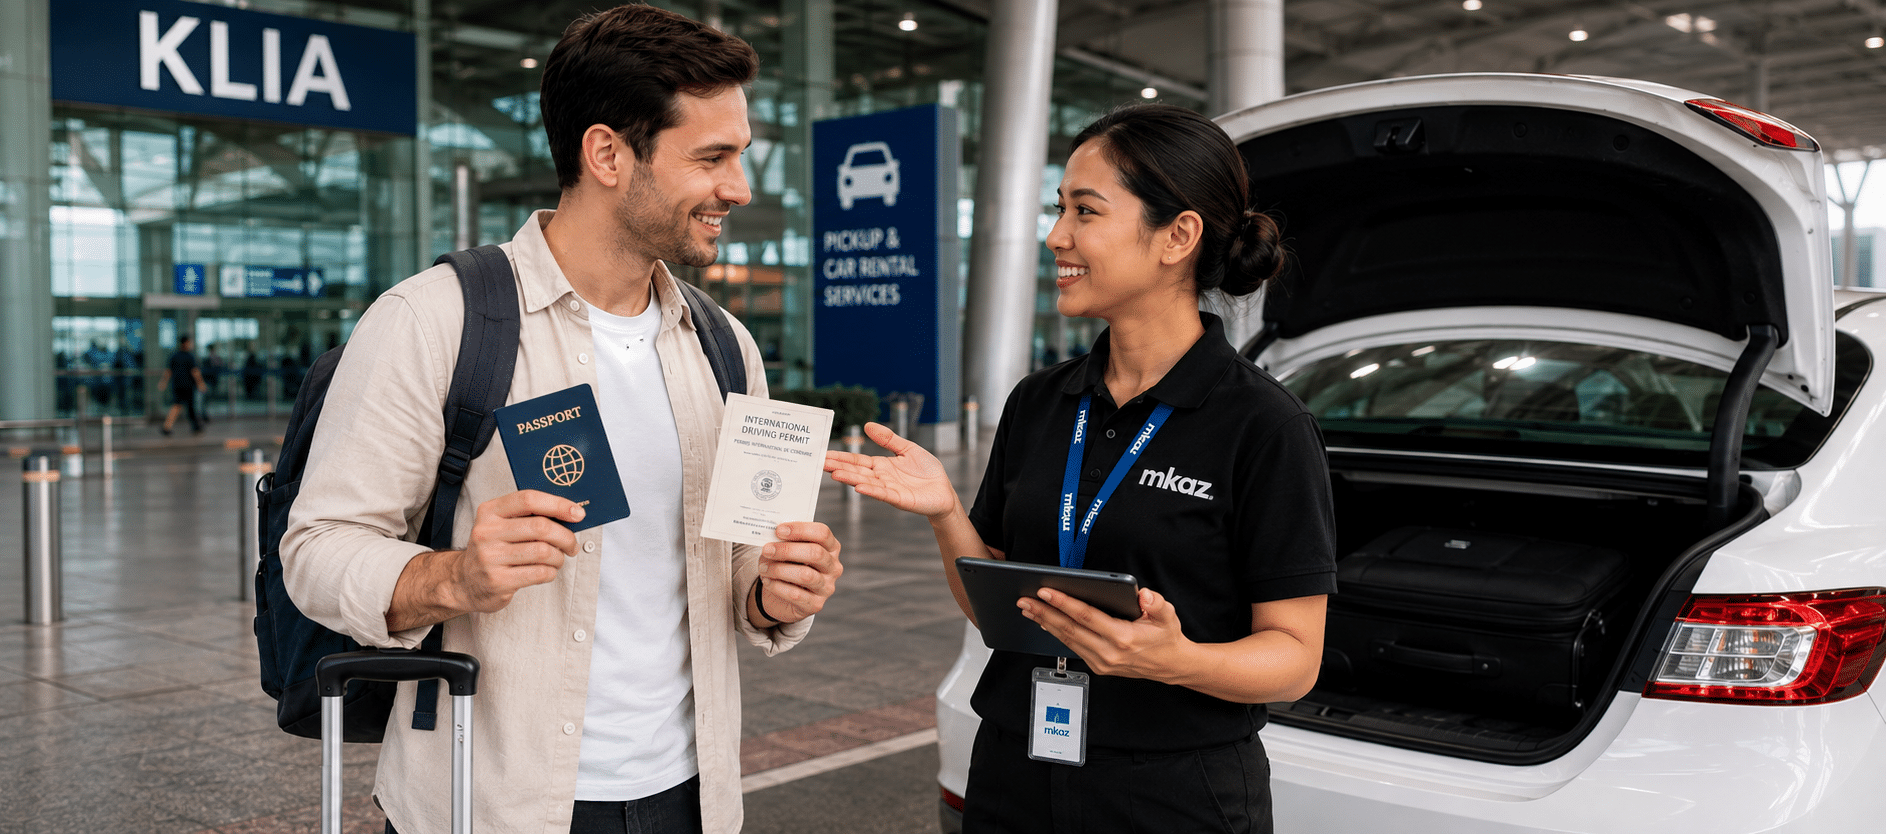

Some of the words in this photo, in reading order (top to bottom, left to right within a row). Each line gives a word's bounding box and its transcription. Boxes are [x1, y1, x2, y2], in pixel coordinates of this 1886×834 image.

[139, 10, 351, 111] KLIA
[823, 227, 884, 251] PICKUP
[886, 227, 900, 249] &
[823, 258, 857, 279] CAR
[859, 255, 920, 277] RENTAL
[824, 284, 901, 307] SERVICES
[516, 406, 581, 435] PASSPORT
[744, 415, 811, 434] INTERNATIONAL
[741, 425, 777, 439] DRIVING
[779, 432, 811, 445] PERMIT
[1044, 726, 1070, 738] mkaz
